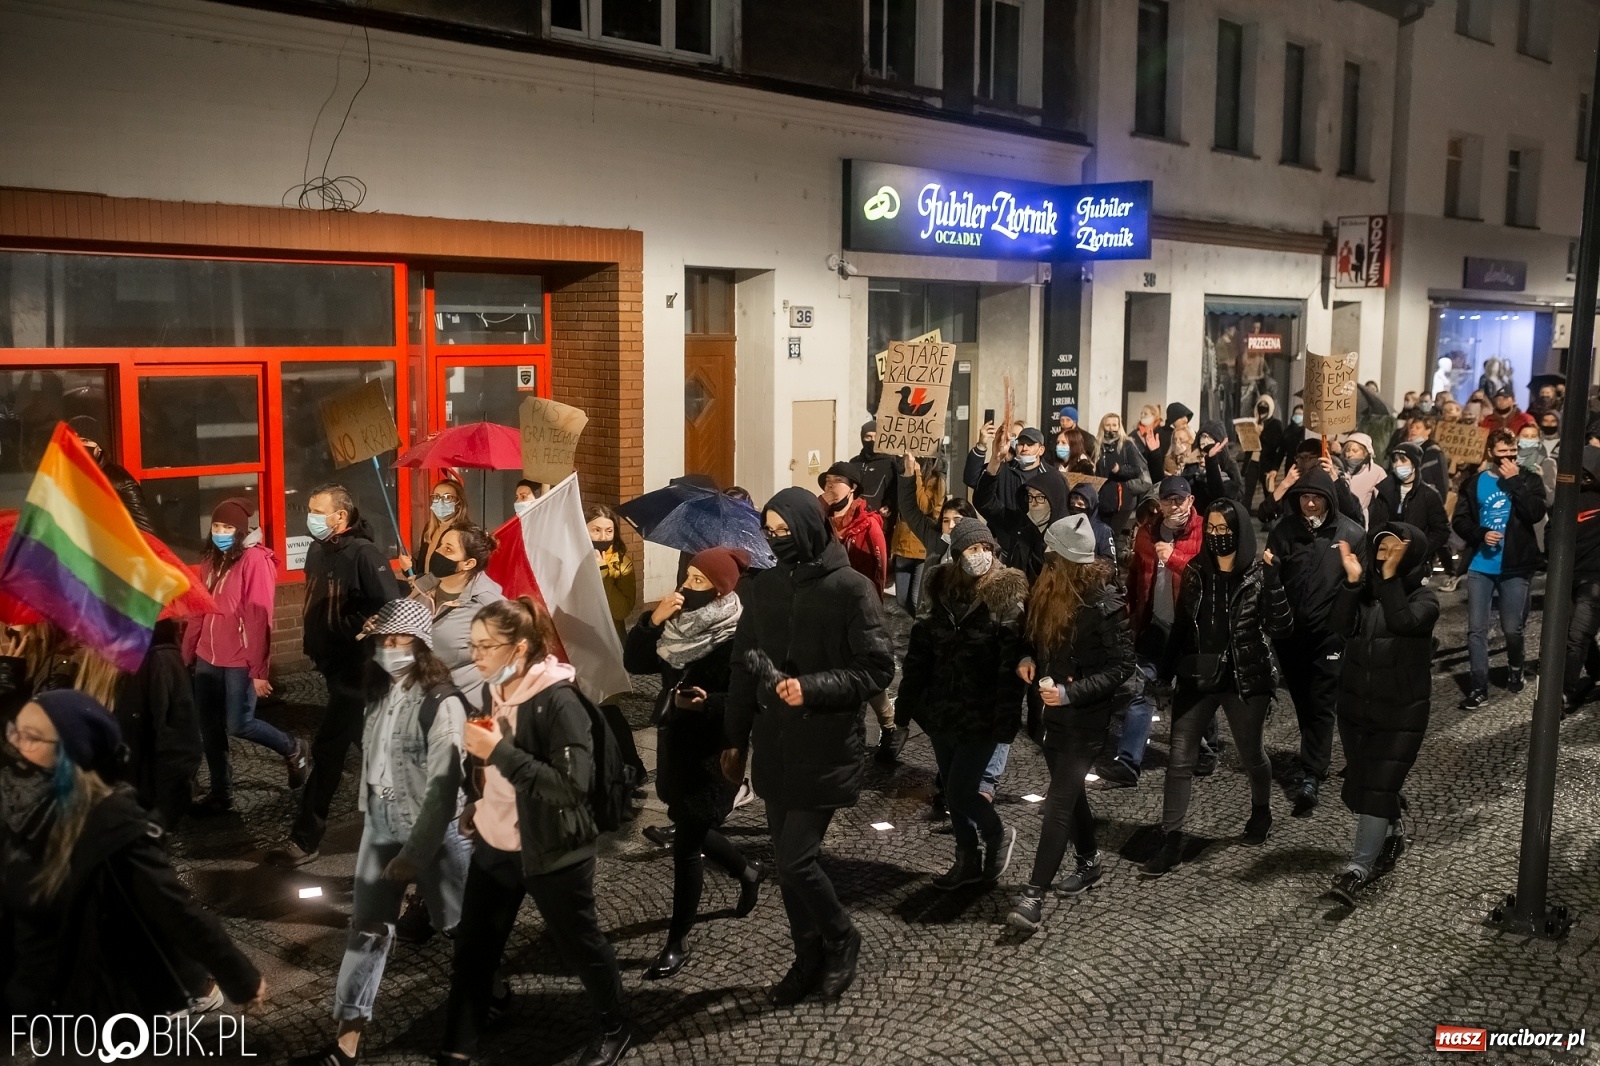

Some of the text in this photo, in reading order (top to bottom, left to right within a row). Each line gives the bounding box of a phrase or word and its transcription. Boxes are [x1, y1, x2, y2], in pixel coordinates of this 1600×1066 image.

[918, 183, 1058, 240] Jubiler Złotnik
[1076, 196, 1134, 226] Jubiler
[935, 230, 983, 247] OCZADŁY
[1076, 226, 1134, 252] Złotnik
[797, 310, 812, 323] 36
[790, 343, 800, 354] 36
[1248, 337, 1281, 350] PRZECENA
[892, 344, 949, 366] STARE
[889, 365, 944, 383] KACZKI
[532, 400, 563, 423] PIS
[523, 425, 545, 443] GRA
[331, 432, 356, 462] NO
